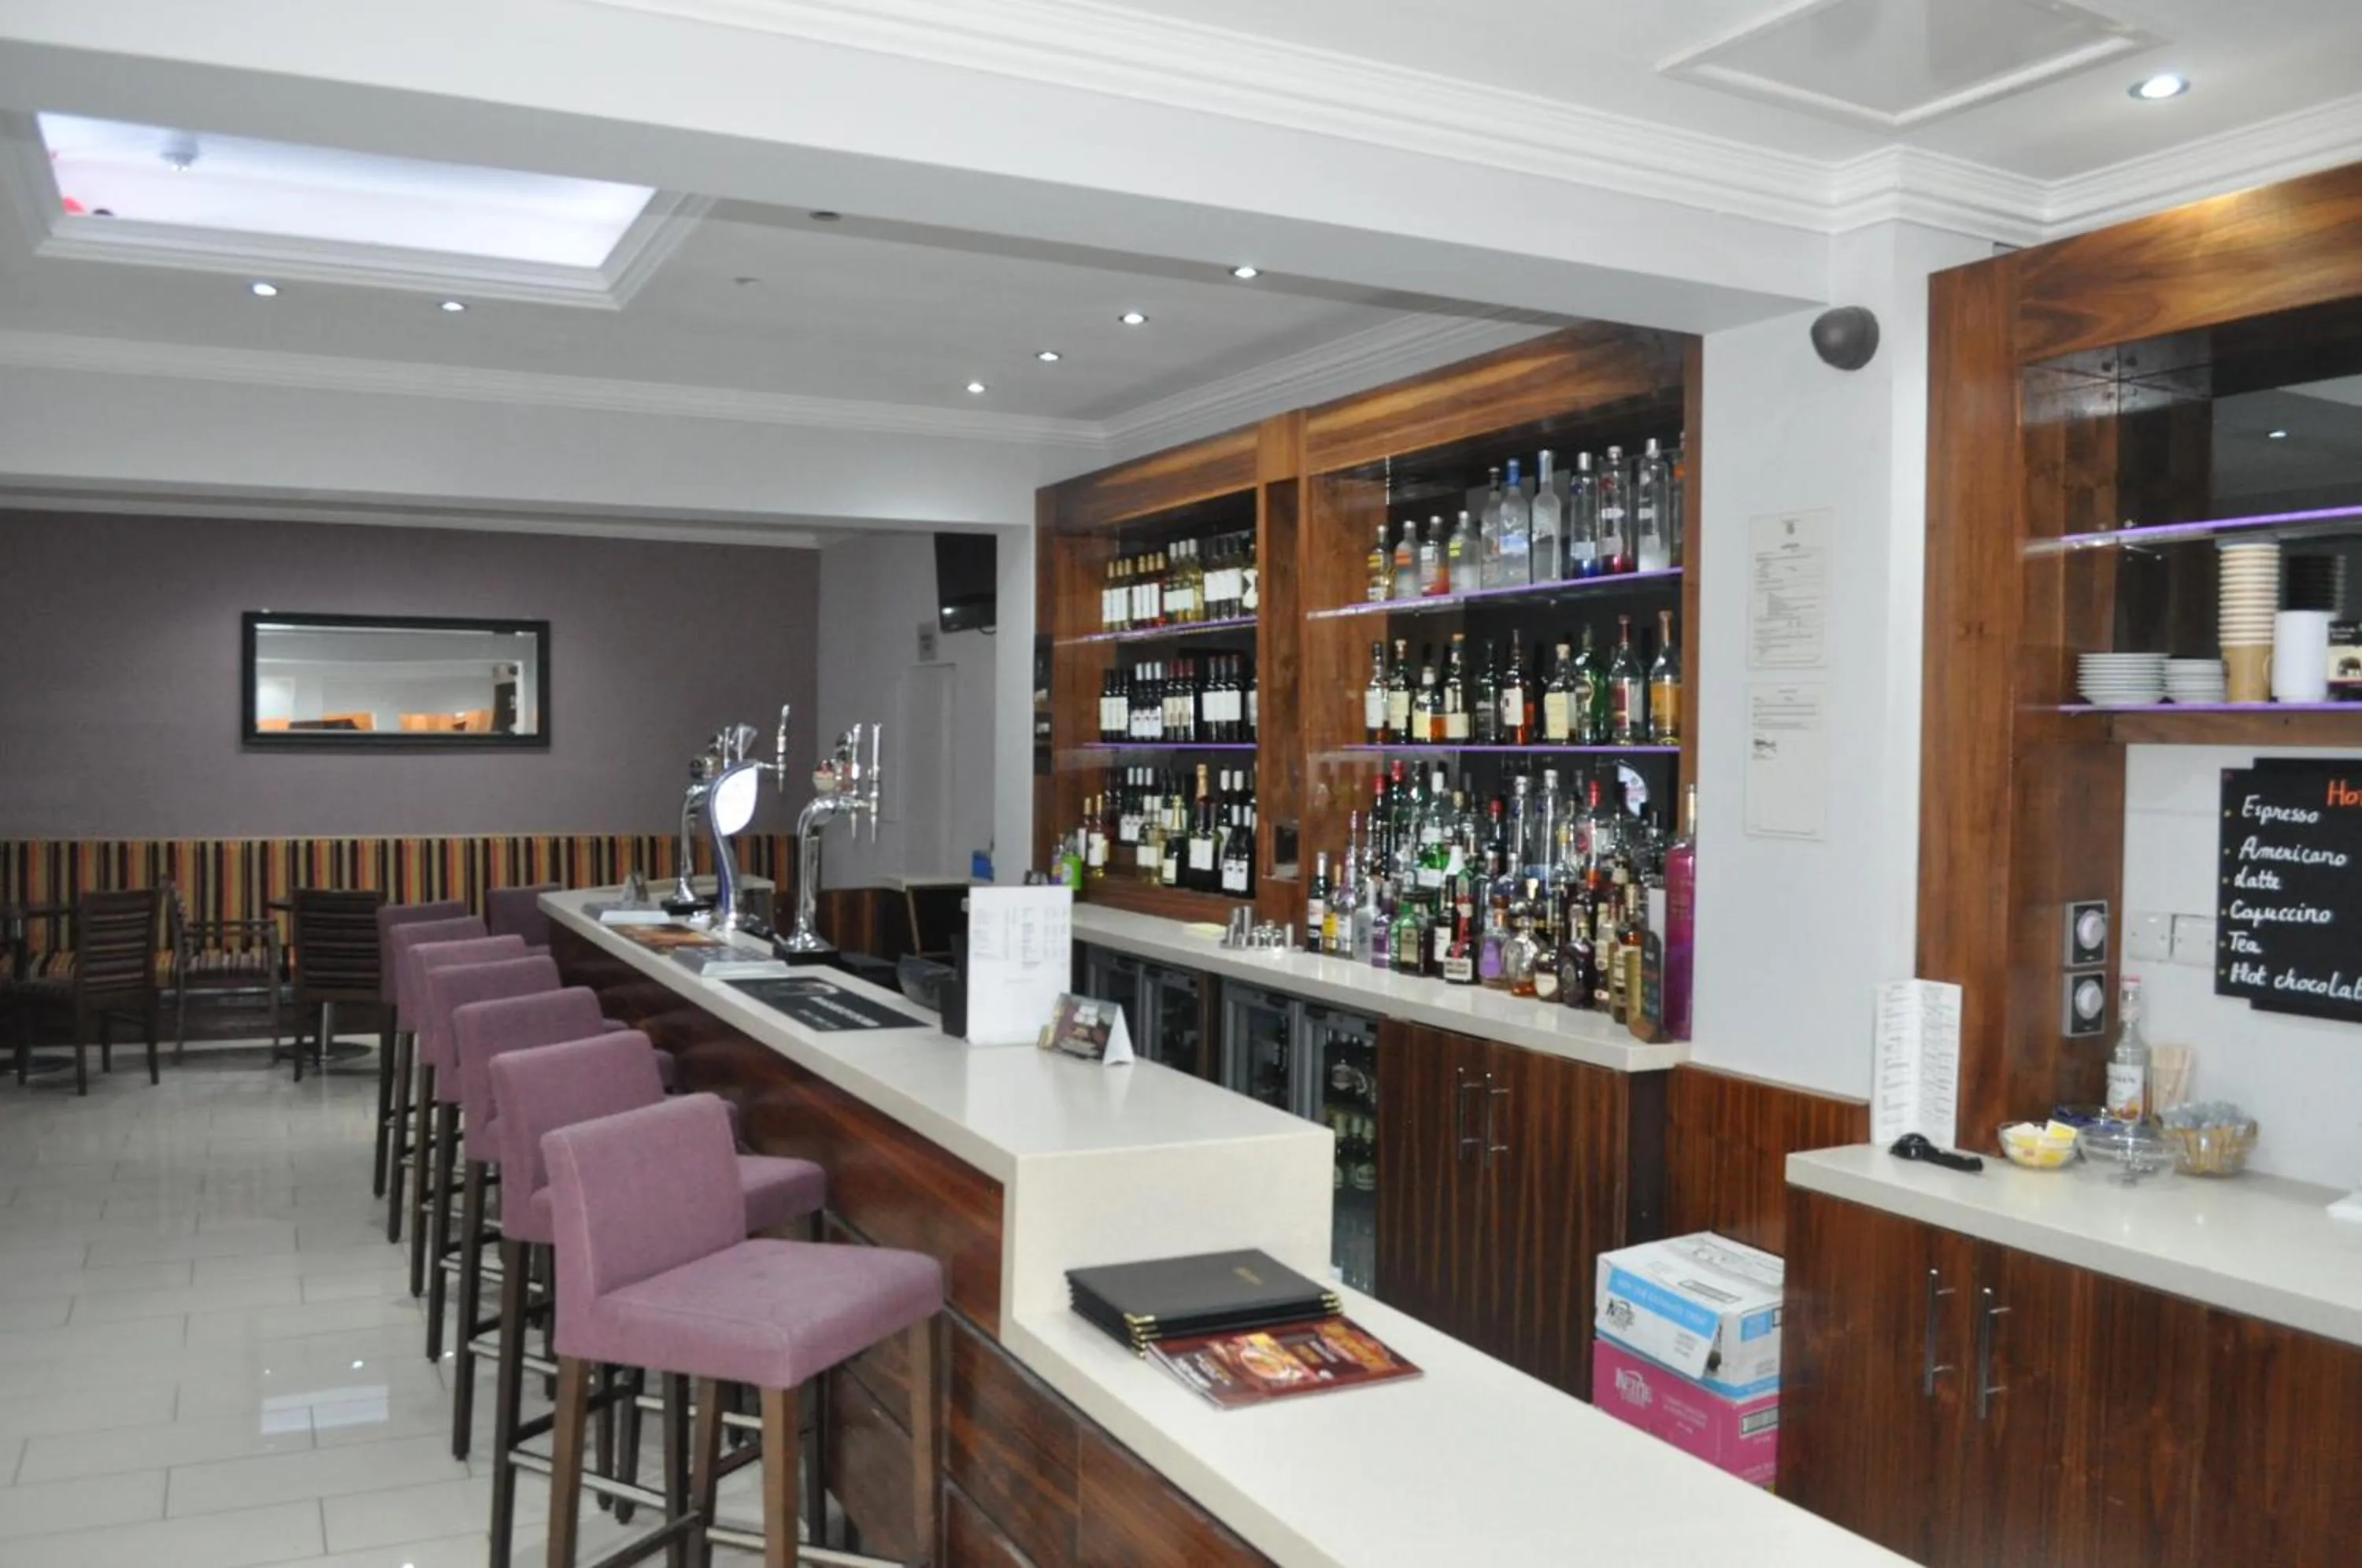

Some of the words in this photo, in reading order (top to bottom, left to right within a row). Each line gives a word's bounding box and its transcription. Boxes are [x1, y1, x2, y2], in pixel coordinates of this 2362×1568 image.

[2242, 794, 2319, 826] Espresso
[2238, 835, 2348, 867] Americano
[2229, 898, 2332, 928] Capuccino
[2227, 930, 2263, 954] Tea
[2229, 961, 2268, 986] Hot
